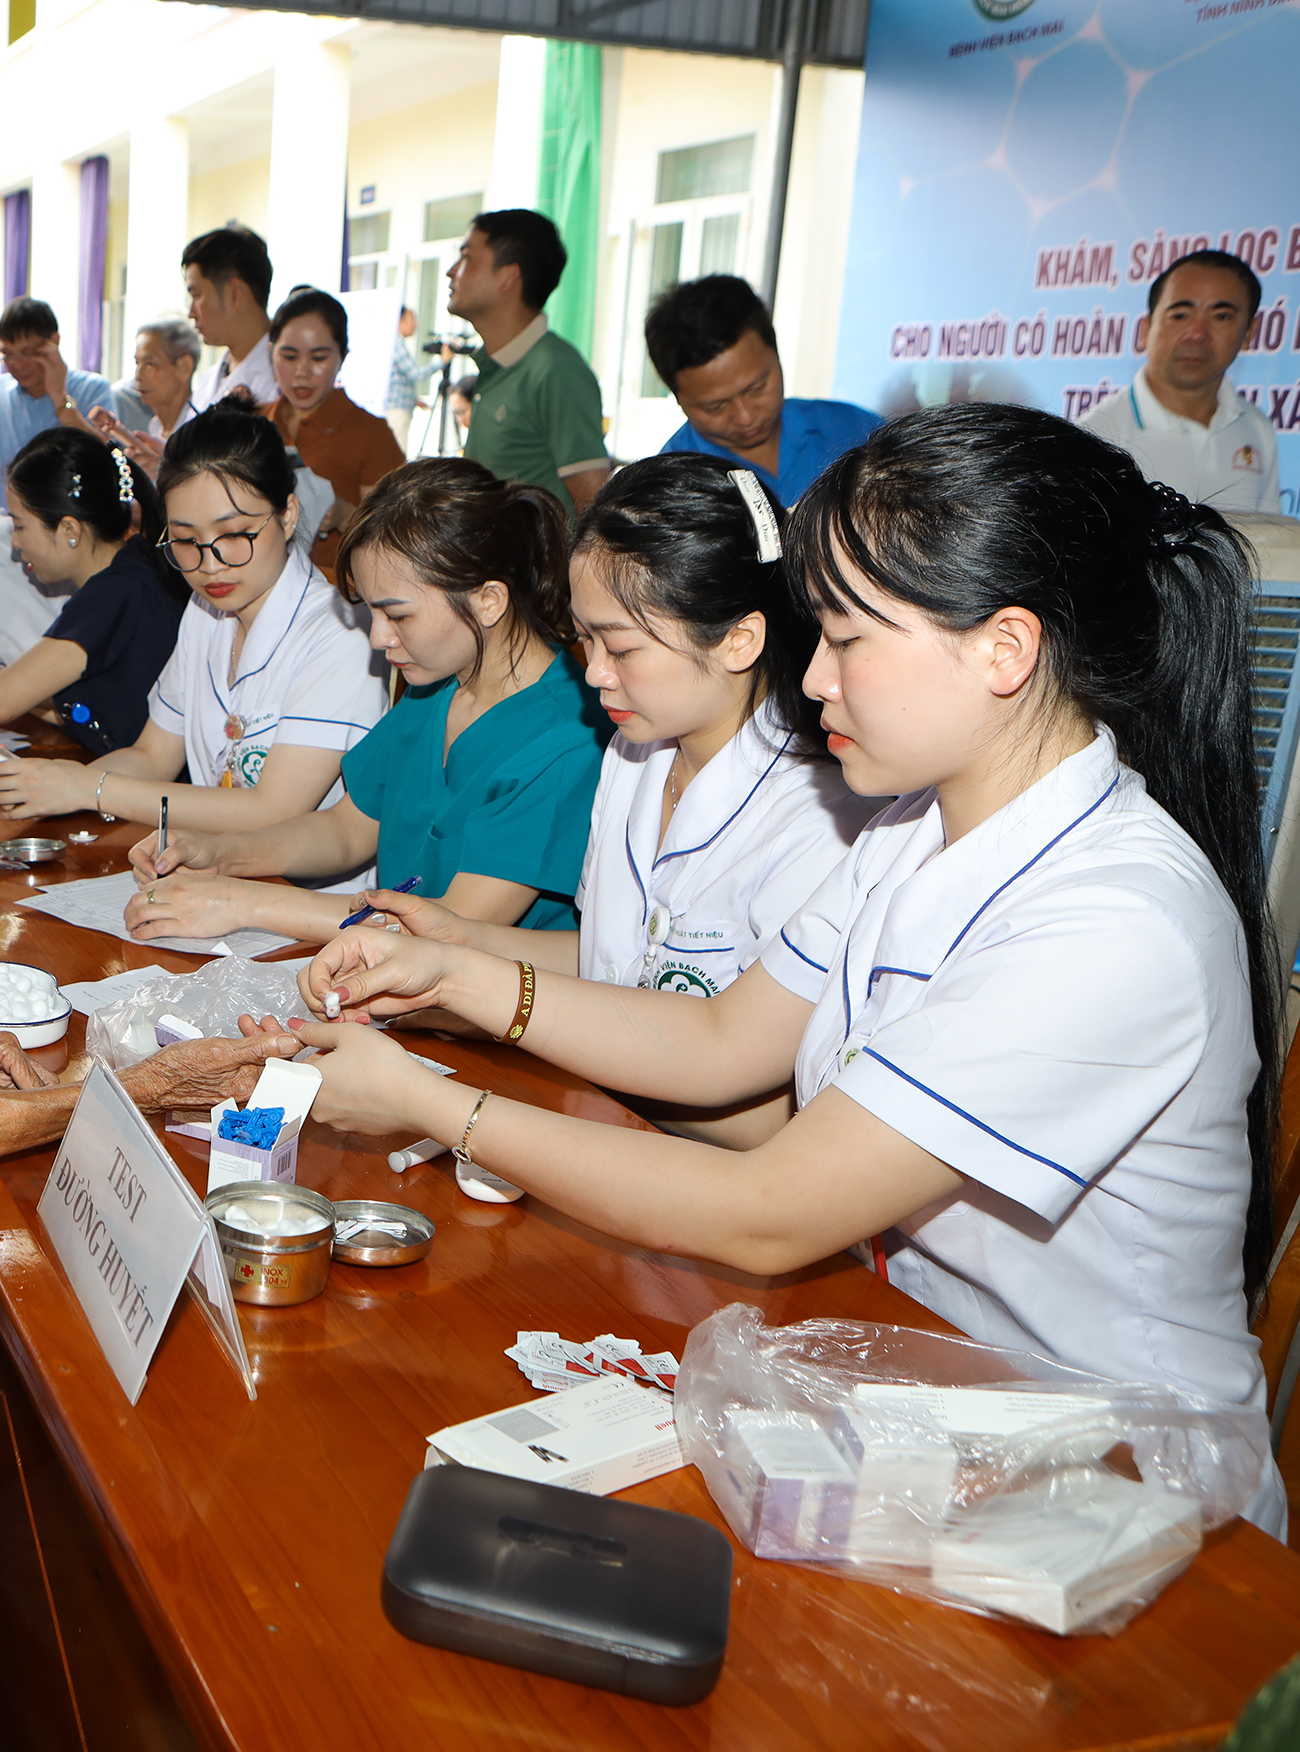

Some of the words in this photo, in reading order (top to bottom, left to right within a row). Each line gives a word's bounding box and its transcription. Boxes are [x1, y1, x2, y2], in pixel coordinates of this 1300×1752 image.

[1036, 237, 1117, 288] KHÁM,
[891, 323, 932, 358] CHO
[1014, 311, 1046, 355] CÓ
[706, 930, 723, 939] NIỆU
[660, 960, 677, 971] VIỆN
[679, 962, 706, 978] BẠCH
[523, 991, 533, 1006] DI
[521, 1007, 531, 1017] A
[107, 1145, 148, 1224] TEST
[55, 1156, 107, 1257] ĐƯỜNG
[97, 1238, 154, 1348] HUYẾT
[261, 1267, 283, 1276] INOX
